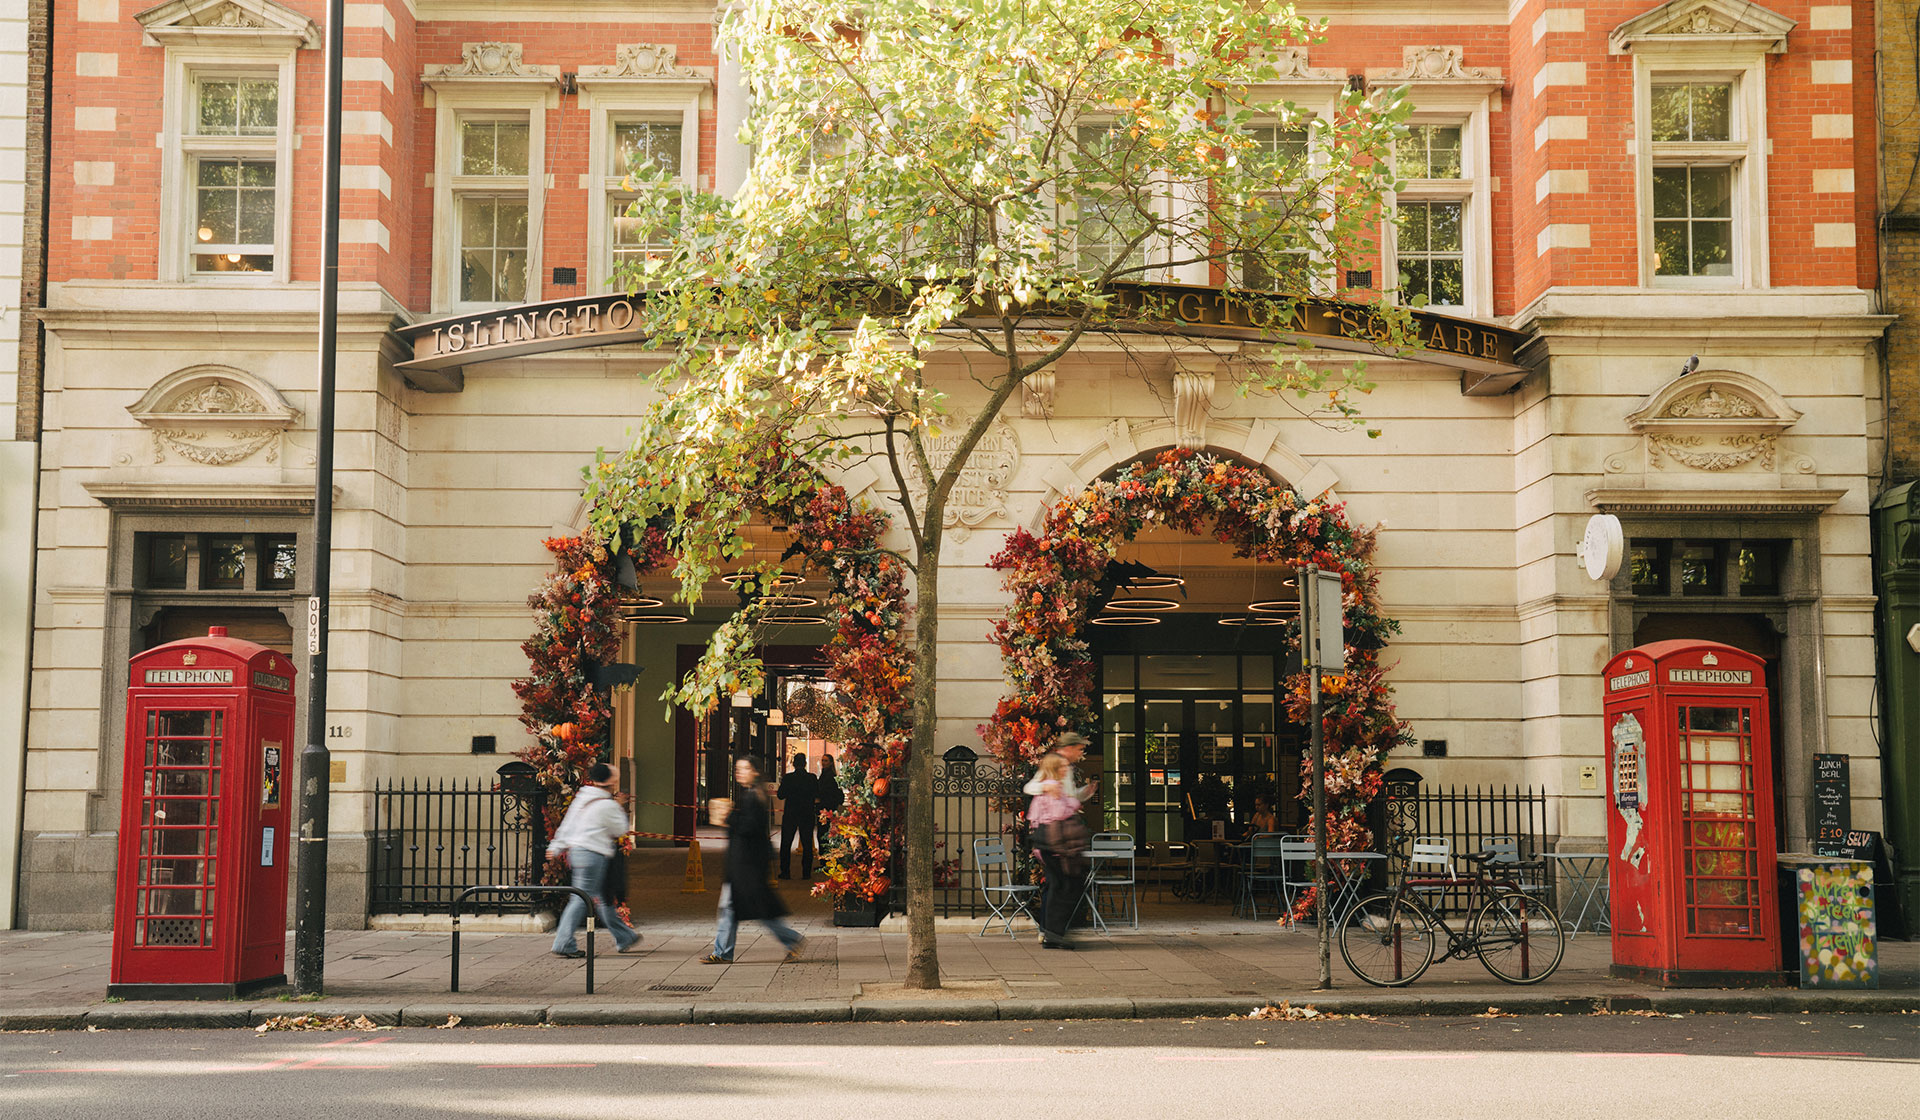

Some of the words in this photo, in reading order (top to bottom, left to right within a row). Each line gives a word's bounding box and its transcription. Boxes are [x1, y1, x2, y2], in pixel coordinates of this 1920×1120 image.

[1060, 288, 1309, 333] INGTON
[432, 298, 662, 356] ISLINGTO
[923, 435, 1003, 452] NORTRN
[928, 453, 996, 470] DISICT
[309, 600, 318, 653] 0045
[151, 671, 231, 683] TELEPHONE
[1612, 670, 1649, 690] TELEPHONE
[1672, 670, 1749, 683] TELEPHONE
[329, 726, 352, 738] 116
[953, 765, 967, 776] ER
[1819, 760, 1841, 769] LUNCH
[1395, 785, 1408, 796] ER
